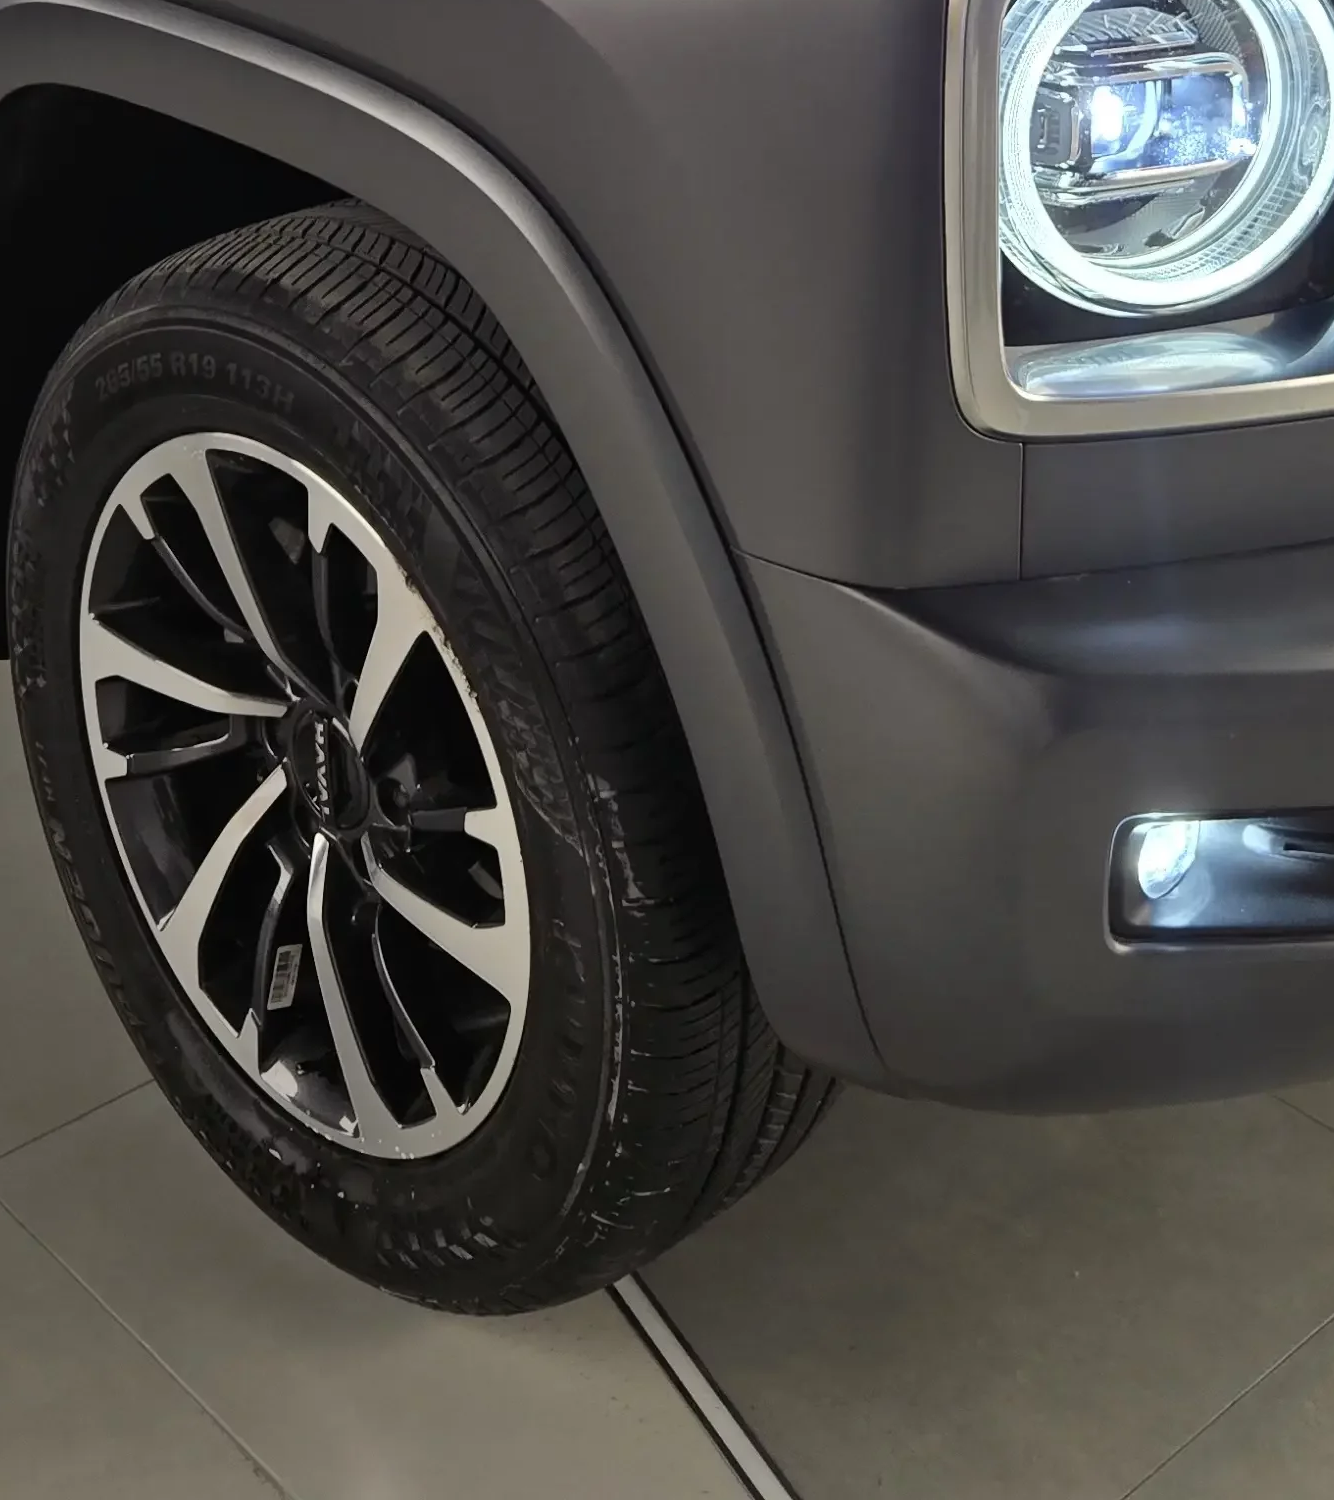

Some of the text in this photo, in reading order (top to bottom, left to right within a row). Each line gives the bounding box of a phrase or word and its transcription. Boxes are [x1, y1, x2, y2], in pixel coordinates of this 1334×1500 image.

[170, 351, 217, 380] R19
[225, 362, 295, 414] 113H
[314, 721, 331, 823] HAVAL
